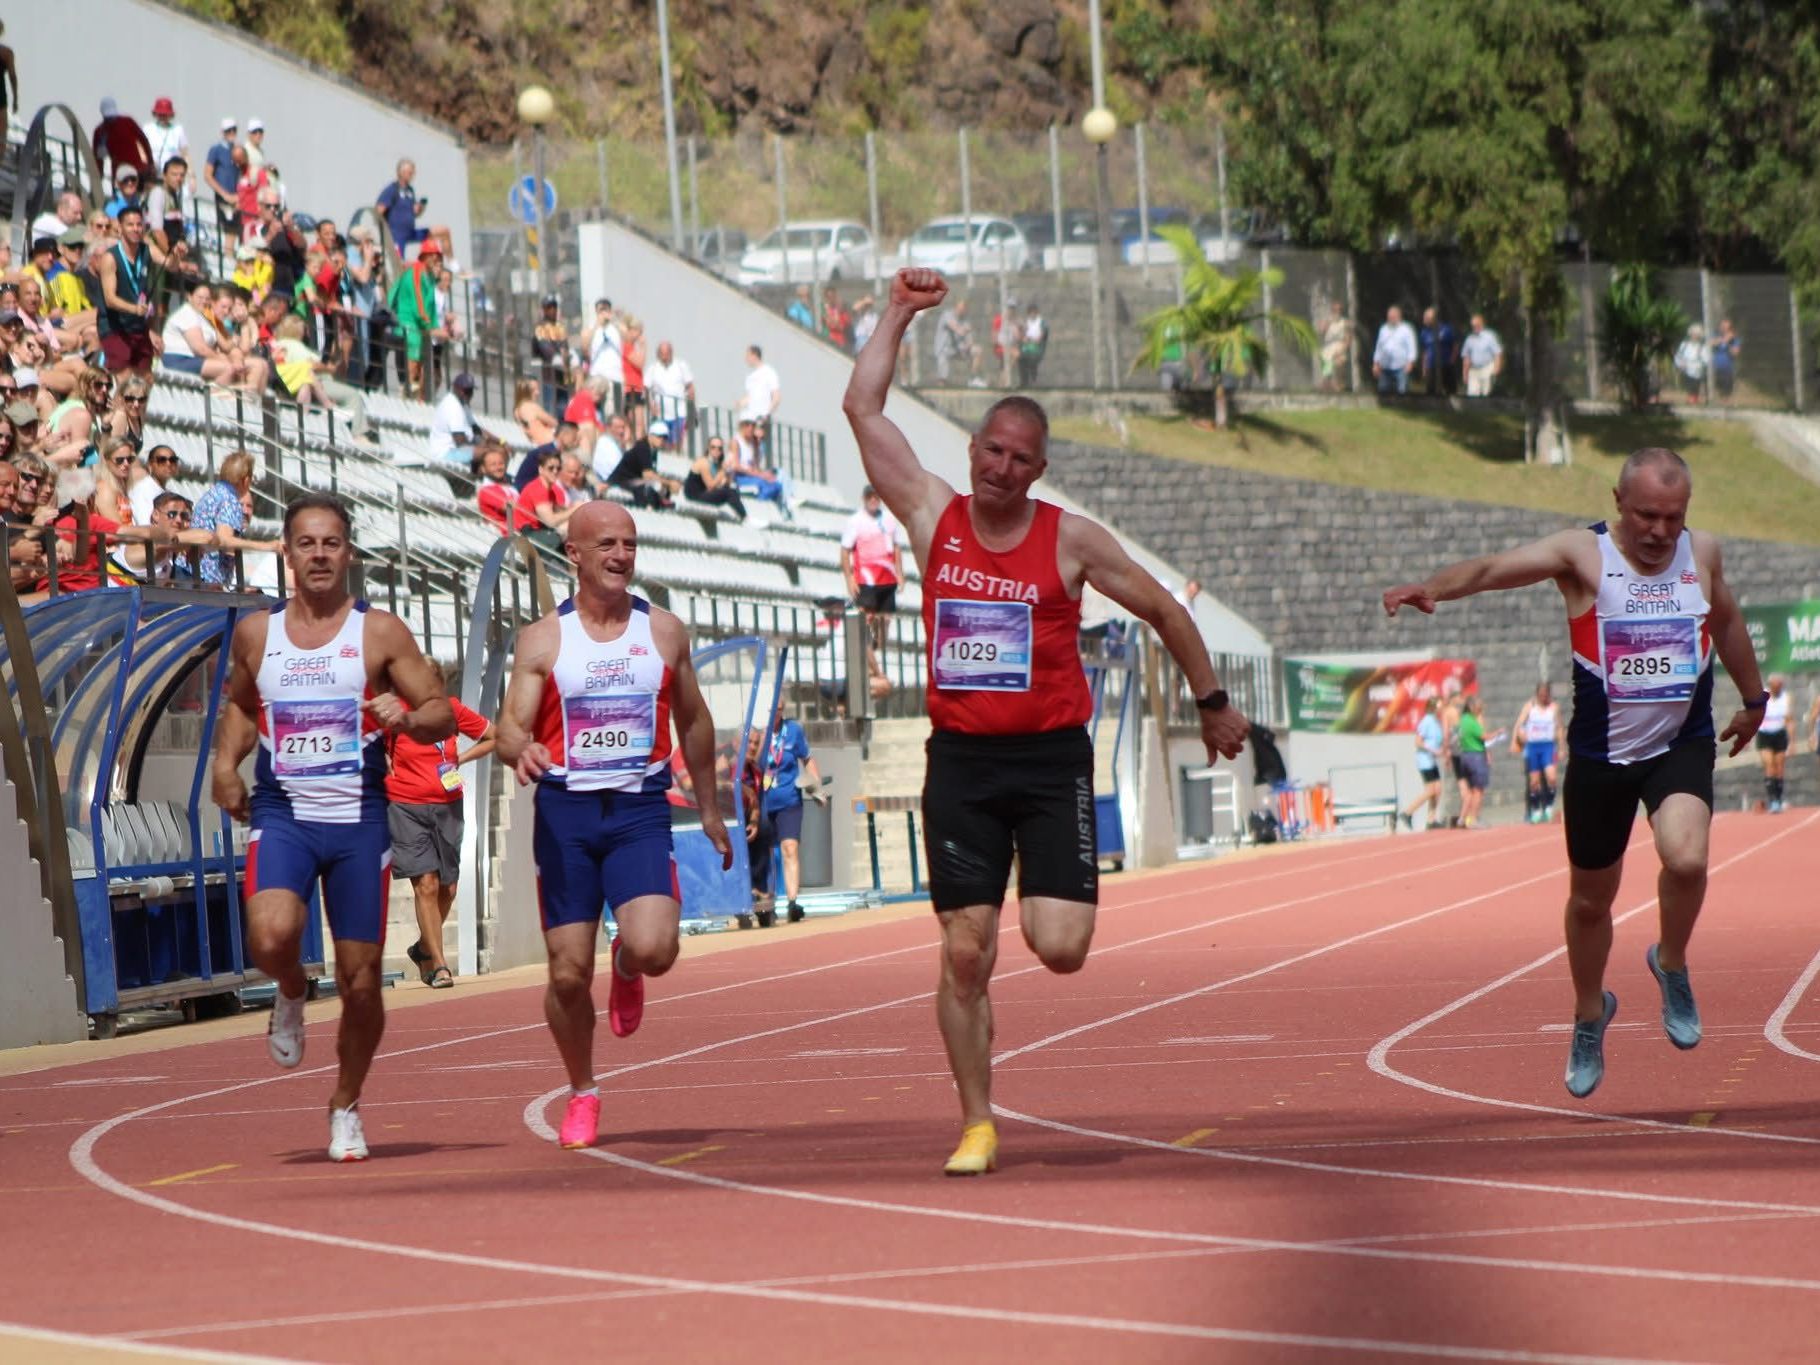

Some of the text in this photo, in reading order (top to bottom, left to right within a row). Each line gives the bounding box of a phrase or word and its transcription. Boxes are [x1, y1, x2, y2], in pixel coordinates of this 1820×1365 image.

[936, 564, 1039, 604] AUSTRIA
[1628, 581, 1677, 597] GREAT
[1625, 598, 1681, 614] BRITAIN
[948, 642, 997, 661] 1029
[284, 655, 333, 670] GREAT
[586, 657, 631, 673] GREAT
[1620, 656, 1671, 676] 2895
[279, 671, 336, 687] BRITAIN
[585, 673, 635, 690] BRITAIN
[286, 736, 332, 753] 2713
[581, 730, 628, 748] 2490
[1076, 776, 1094, 867] AUSTRIA
